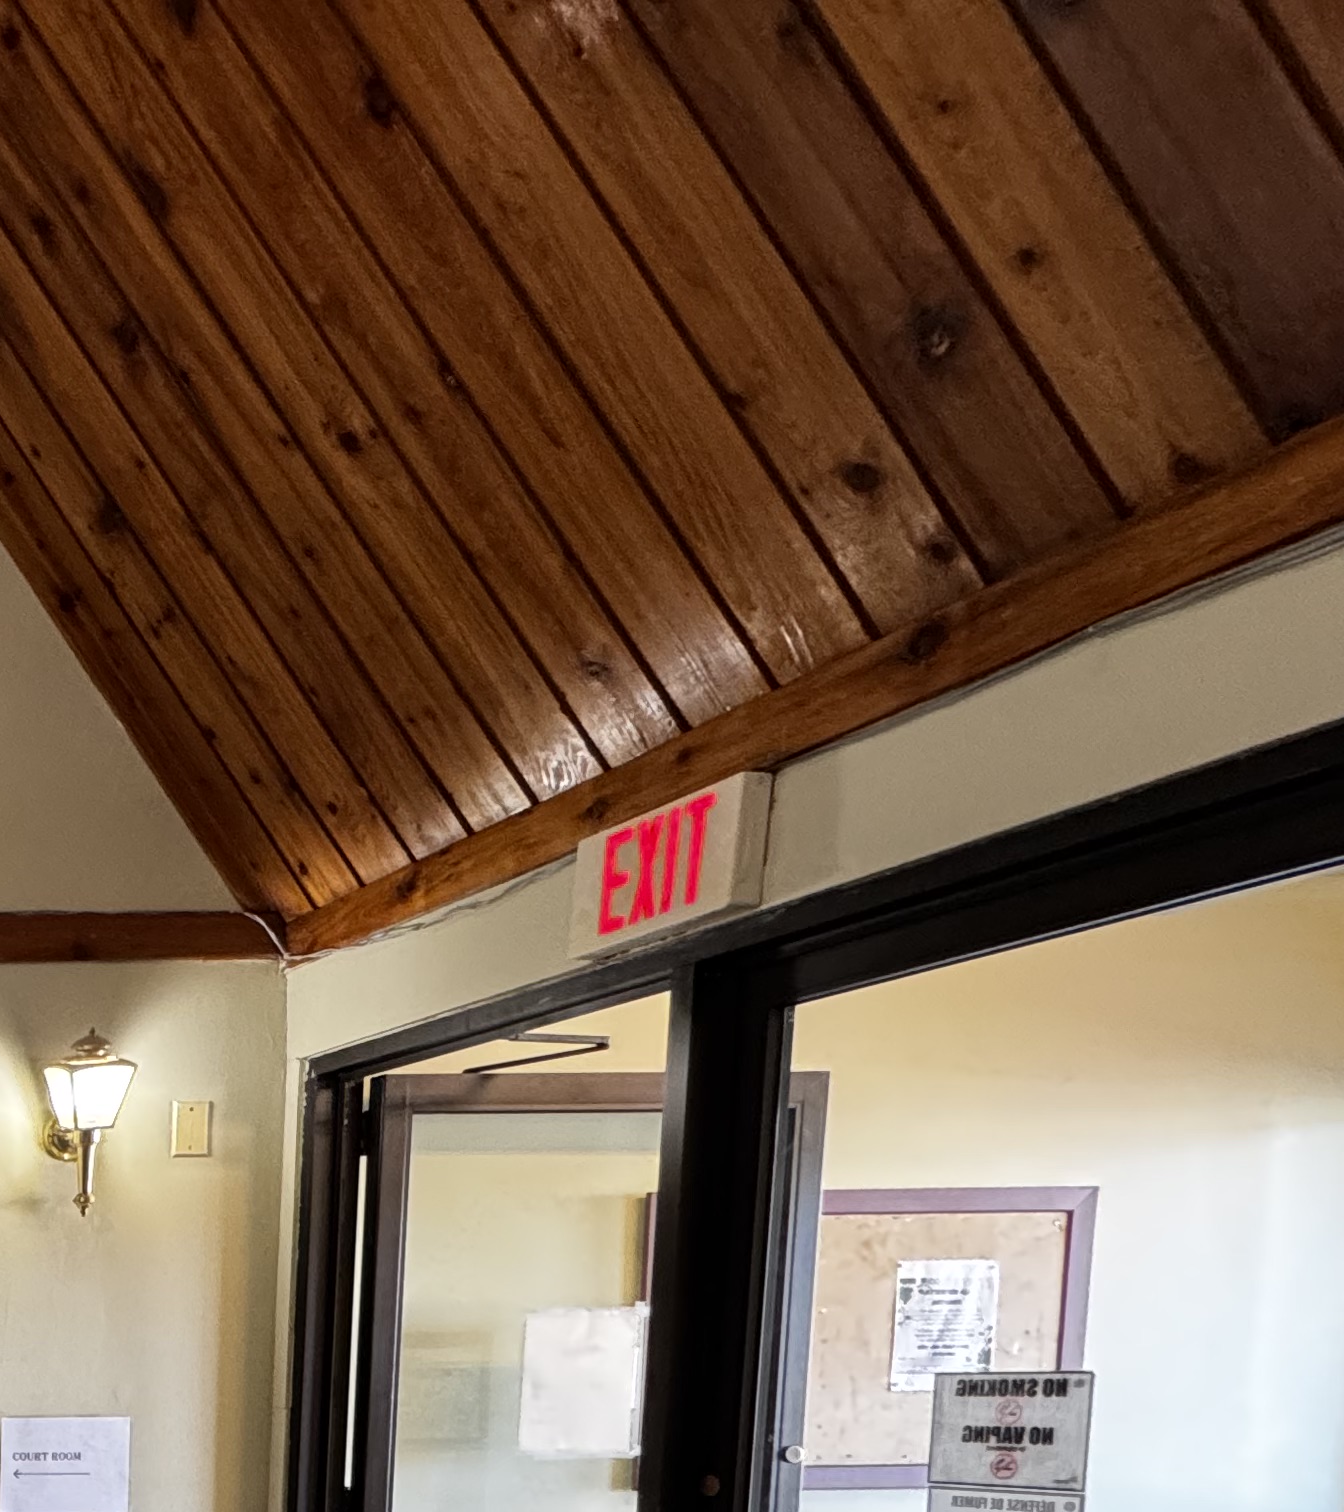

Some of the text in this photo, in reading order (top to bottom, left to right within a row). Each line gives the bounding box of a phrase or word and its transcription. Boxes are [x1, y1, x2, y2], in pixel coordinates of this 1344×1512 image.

[598, 792, 718, 936] EXIT
[12, 1452, 82, 1461] COURT ROOM
